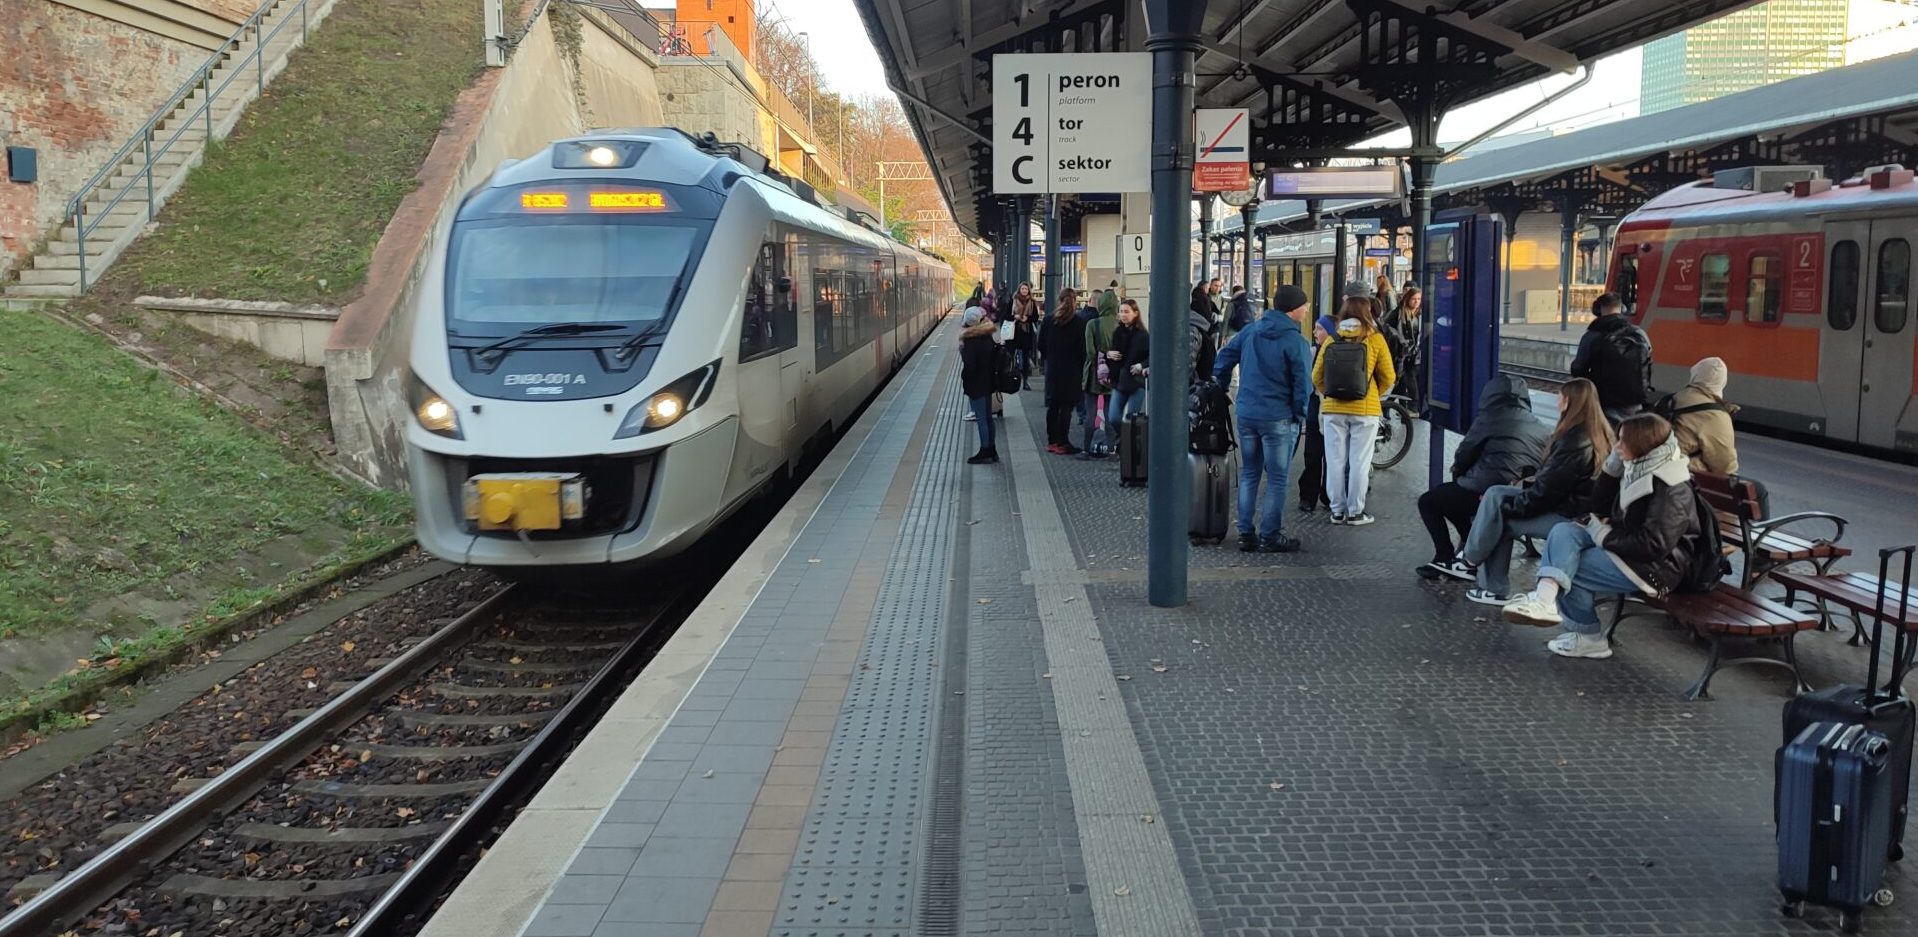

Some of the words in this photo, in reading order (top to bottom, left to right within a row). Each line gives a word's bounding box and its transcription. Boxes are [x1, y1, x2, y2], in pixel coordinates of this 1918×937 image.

[1014, 74, 1029, 107] 1
[1059, 75, 1120, 93] peron
[1058, 96, 1096, 106] platform
[1012, 117, 1034, 146] 4
[1058, 118, 1084, 130] tor
[1012, 155, 1034, 184] C
[1058, 155, 1112, 170] sektor
[1135, 236, 1143, 251] 0
[1800, 241, 1811, 267] 2
[1138, 255, 1142, 271] 1
